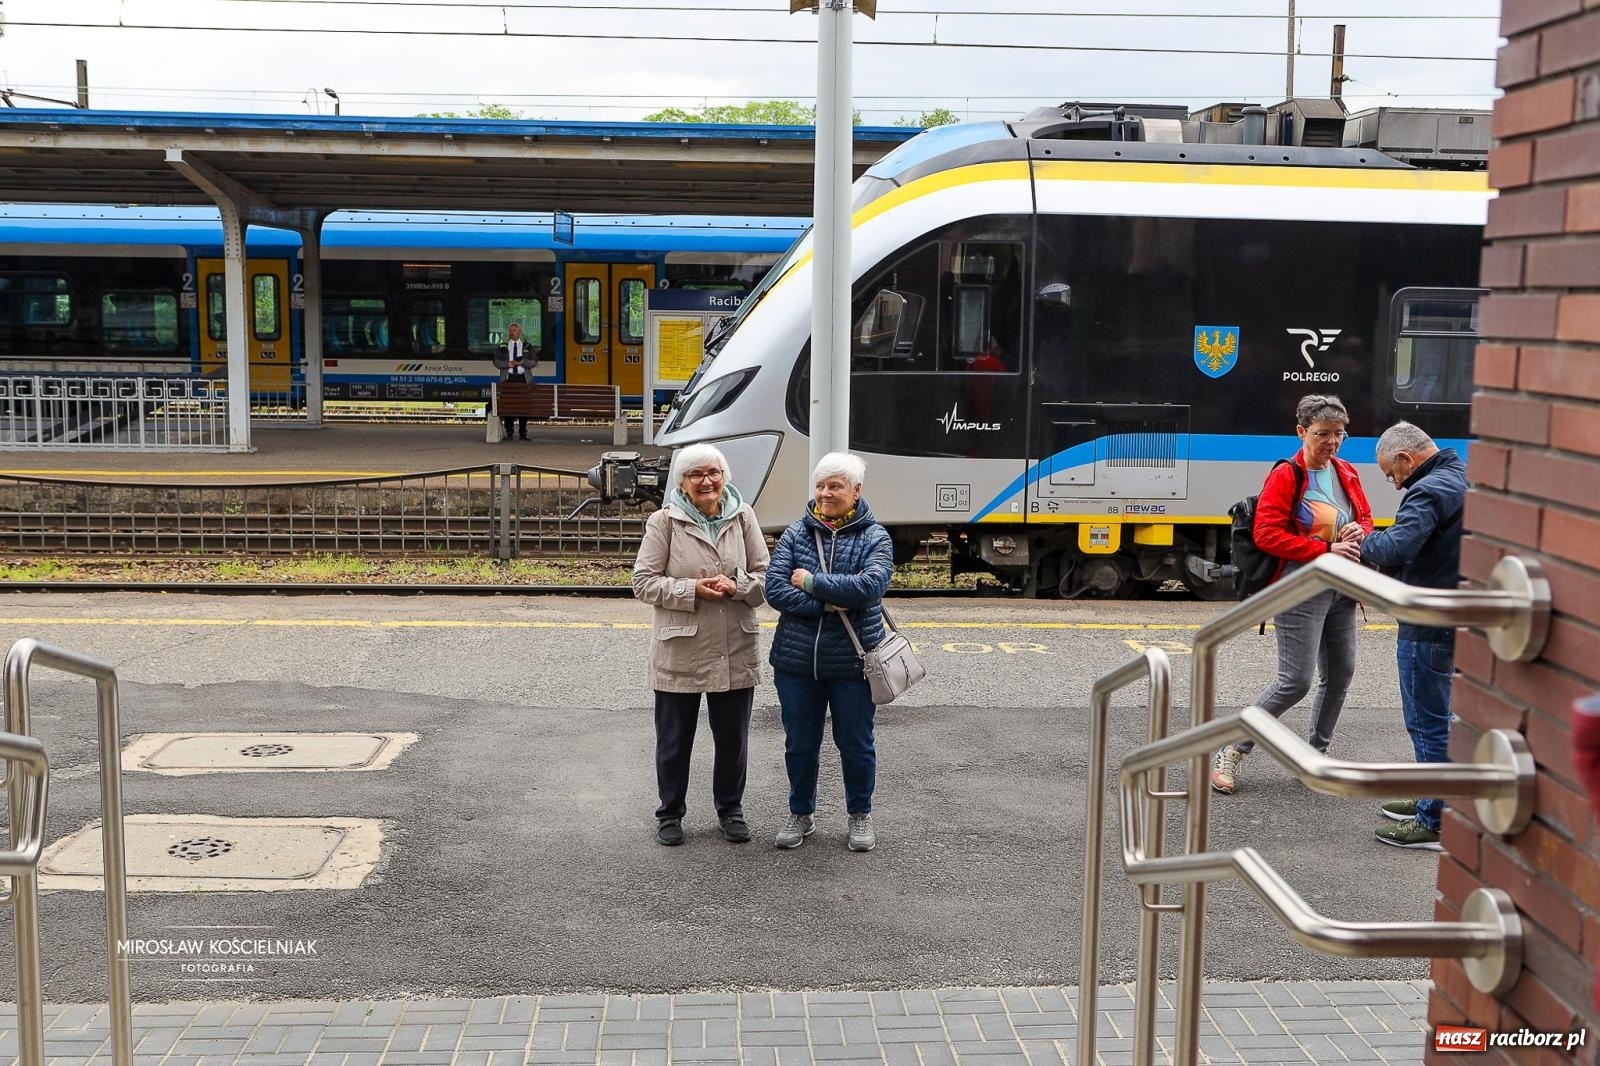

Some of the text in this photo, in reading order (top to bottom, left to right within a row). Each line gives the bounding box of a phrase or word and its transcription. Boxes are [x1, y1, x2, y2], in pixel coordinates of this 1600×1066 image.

[182, 273, 193, 291] 2
[293, 274, 304, 291] 2
[550, 277, 561, 295] 2
[1283, 372, 1340, 382] POLREGIO
[952, 422, 1002, 431] IMPULS
[942, 494, 955, 502] G1
[1031, 501, 1040, 514] B
[1107, 506, 1119, 514] 8B
[1125, 504, 1166, 512] newag
